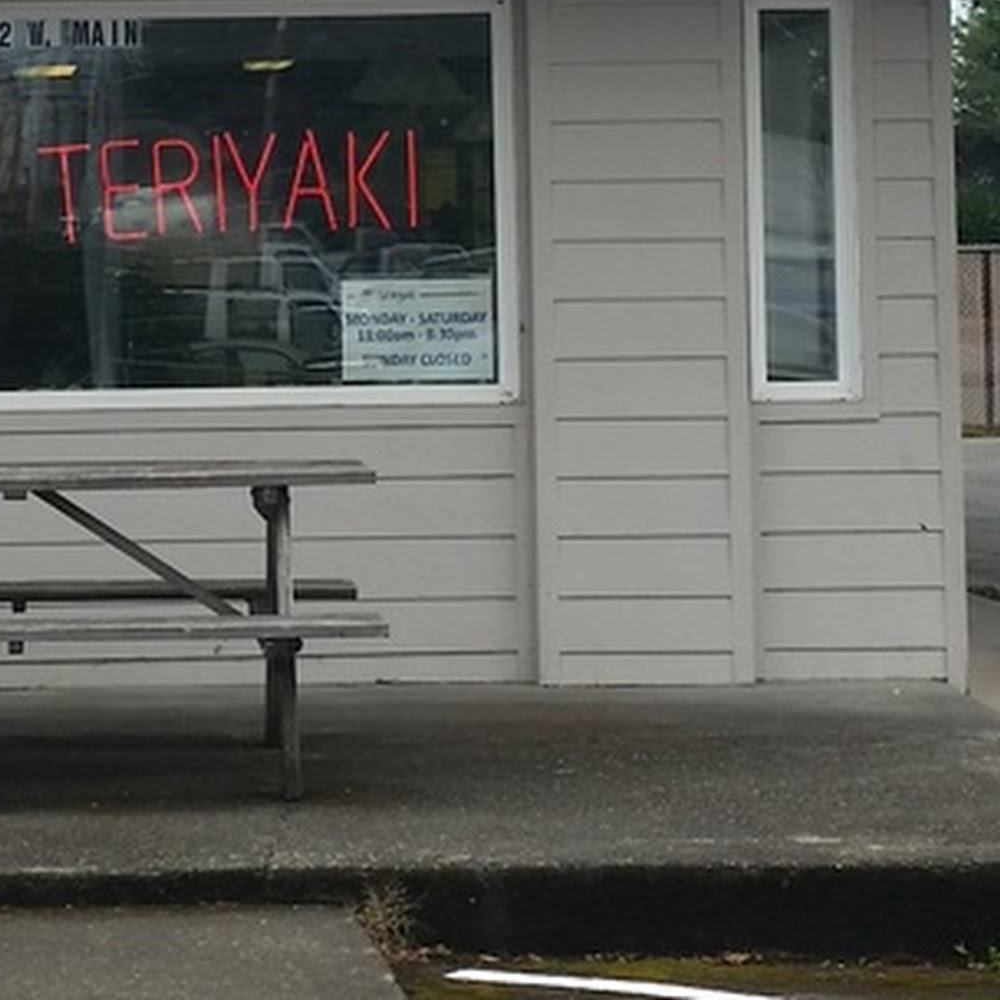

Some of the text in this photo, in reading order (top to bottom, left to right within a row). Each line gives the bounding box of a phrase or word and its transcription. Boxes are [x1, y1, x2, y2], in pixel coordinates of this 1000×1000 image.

[73, 19, 138, 47] MAIN
[37, 128, 419, 245] TERIYAKI
[418, 310, 488, 326] SATURDAY
